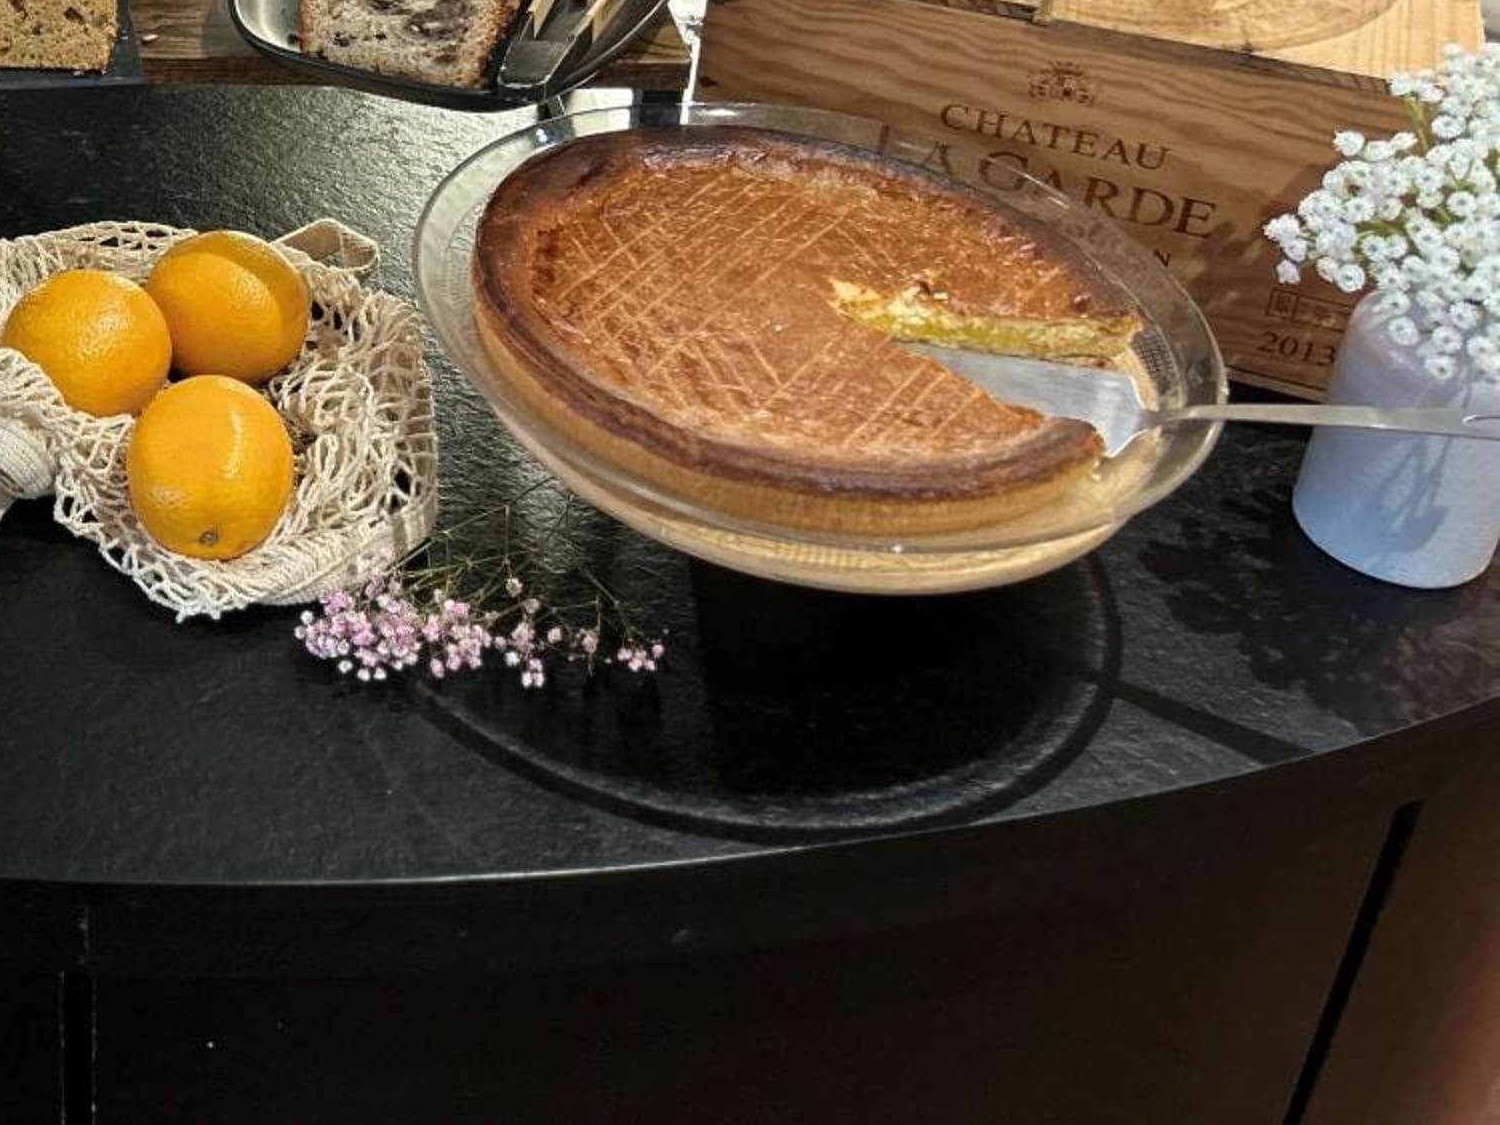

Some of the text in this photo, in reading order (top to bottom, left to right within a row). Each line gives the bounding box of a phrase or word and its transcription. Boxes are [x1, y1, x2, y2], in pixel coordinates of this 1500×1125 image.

[940, 104, 1171, 172] CHATEAU
[979, 151, 1216, 238] GARDE
[1257, 331, 1337, 367] 2013
